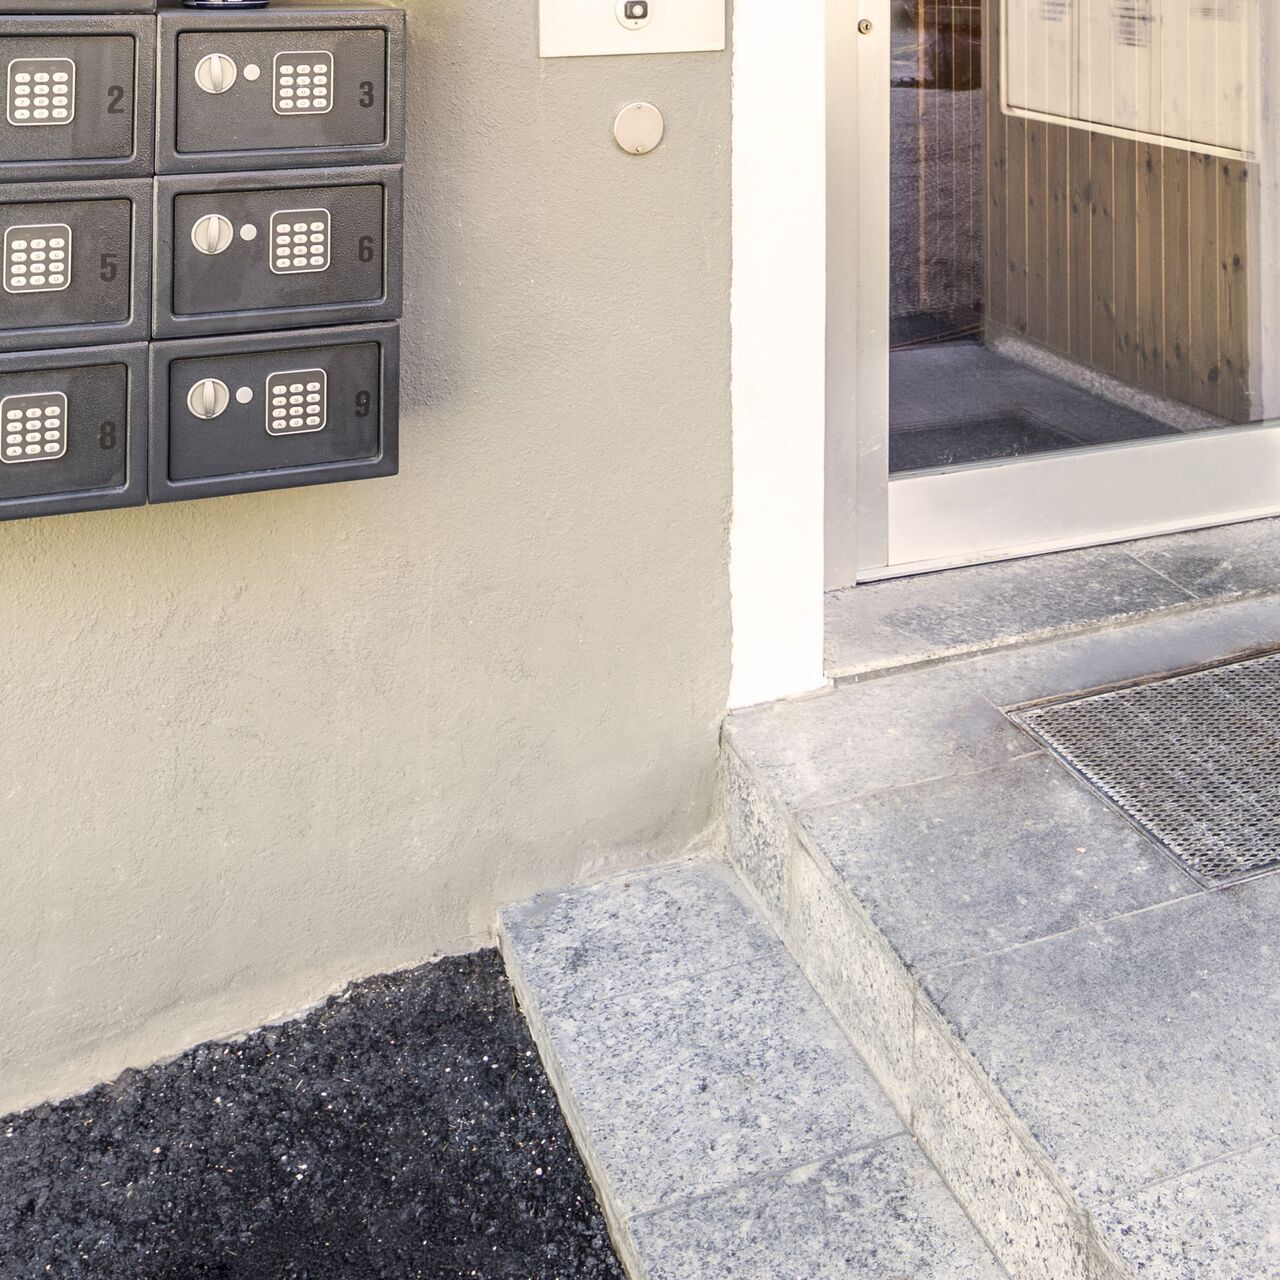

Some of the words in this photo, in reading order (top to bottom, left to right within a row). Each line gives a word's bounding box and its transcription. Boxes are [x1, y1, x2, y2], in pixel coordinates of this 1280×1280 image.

[107, 85, 124, 114] 2
[359, 81, 374, 108] 3
[358, 236, 373, 263] 6
[100, 253, 117, 282] 5
[355, 391, 371, 417] 9
[99, 421, 116, 450] 8
